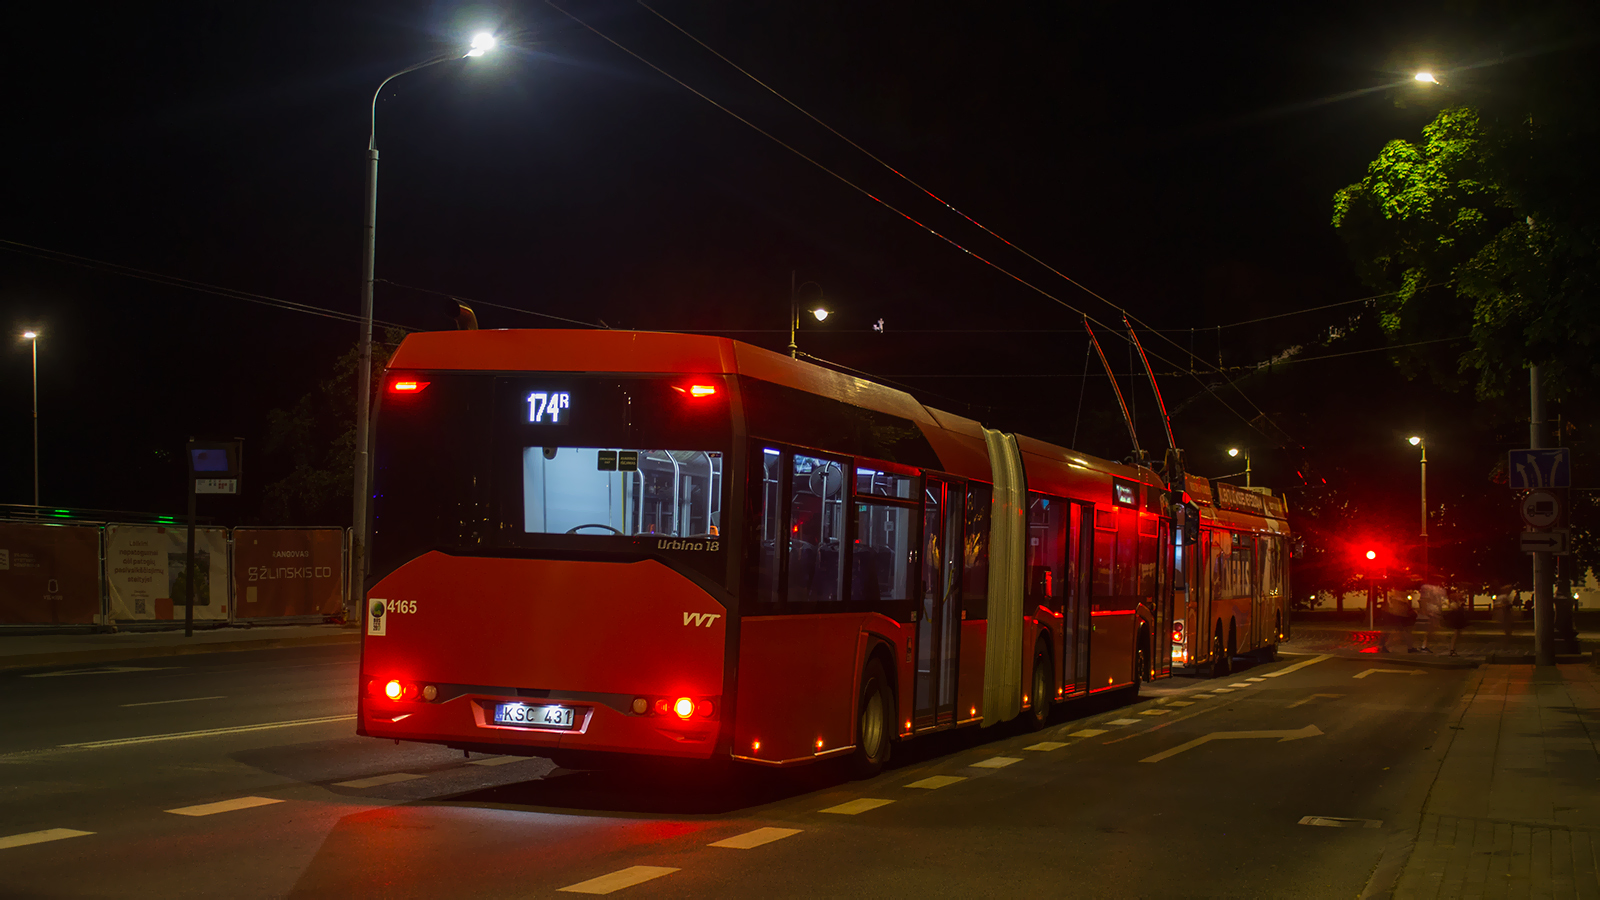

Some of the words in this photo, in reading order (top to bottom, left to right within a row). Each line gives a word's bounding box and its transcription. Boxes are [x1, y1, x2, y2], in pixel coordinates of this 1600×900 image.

[657, 539, 703, 551] Urbino
[705, 540, 720, 552] 18
[272, 550, 309, 558] RANGOVAS
[315, 566, 332, 578] CO
[387, 599, 418, 614] 4165
[504, 706, 535, 722] KSC
[544, 709, 571, 725] 431
